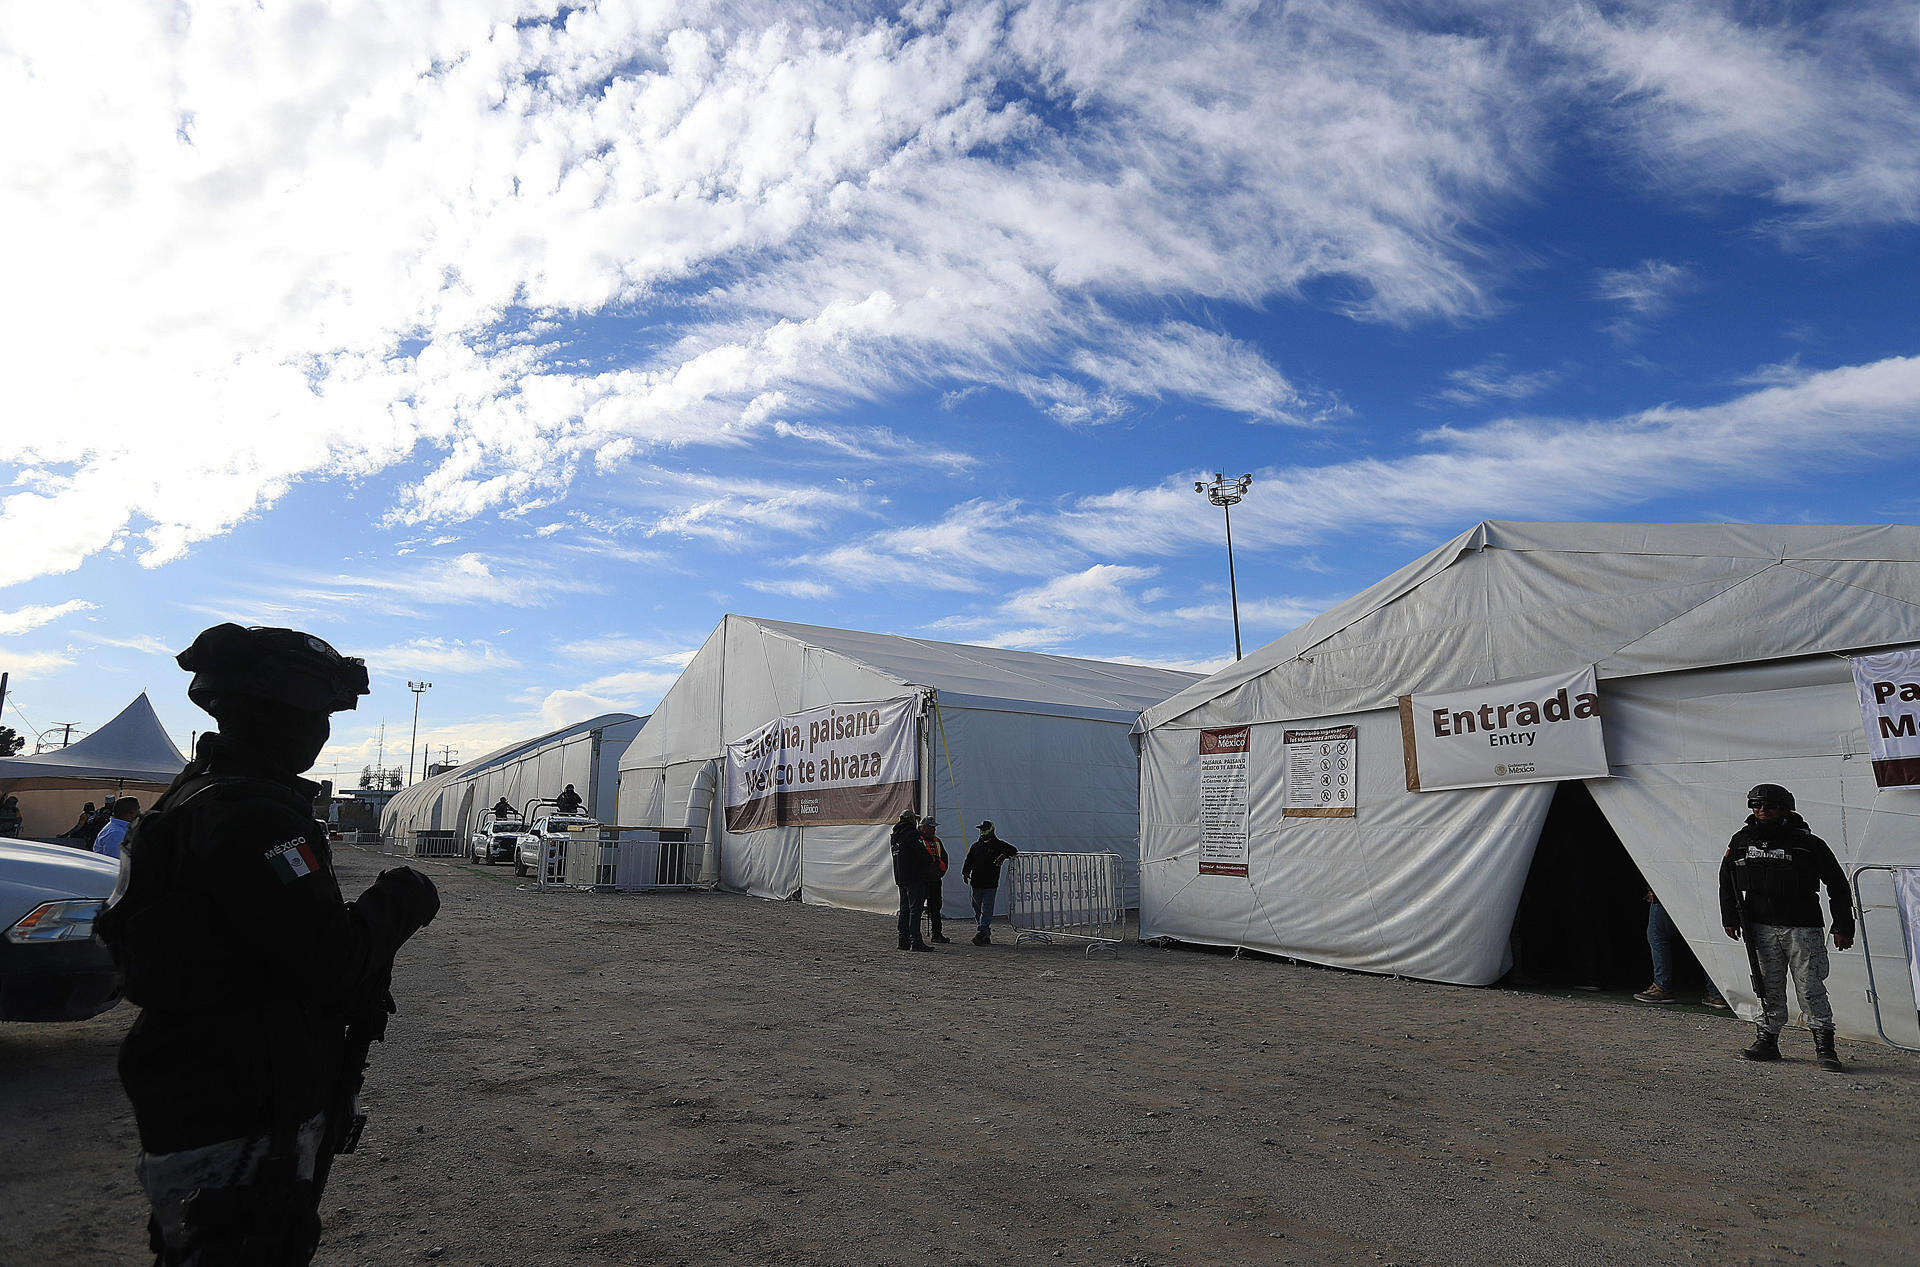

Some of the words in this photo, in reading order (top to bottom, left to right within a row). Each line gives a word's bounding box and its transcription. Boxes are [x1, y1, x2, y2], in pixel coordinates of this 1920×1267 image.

[1432, 688, 1600, 738] Entrada
[809, 709, 880, 754] paisano
[1489, 731, 1536, 747] Entry
[1878, 714, 1920, 739] M
[798, 757, 815, 784] te
[820, 750, 882, 782] abraza
[1508, 765, 1535, 774] México
[264, 837, 306, 860] MÉXICO
